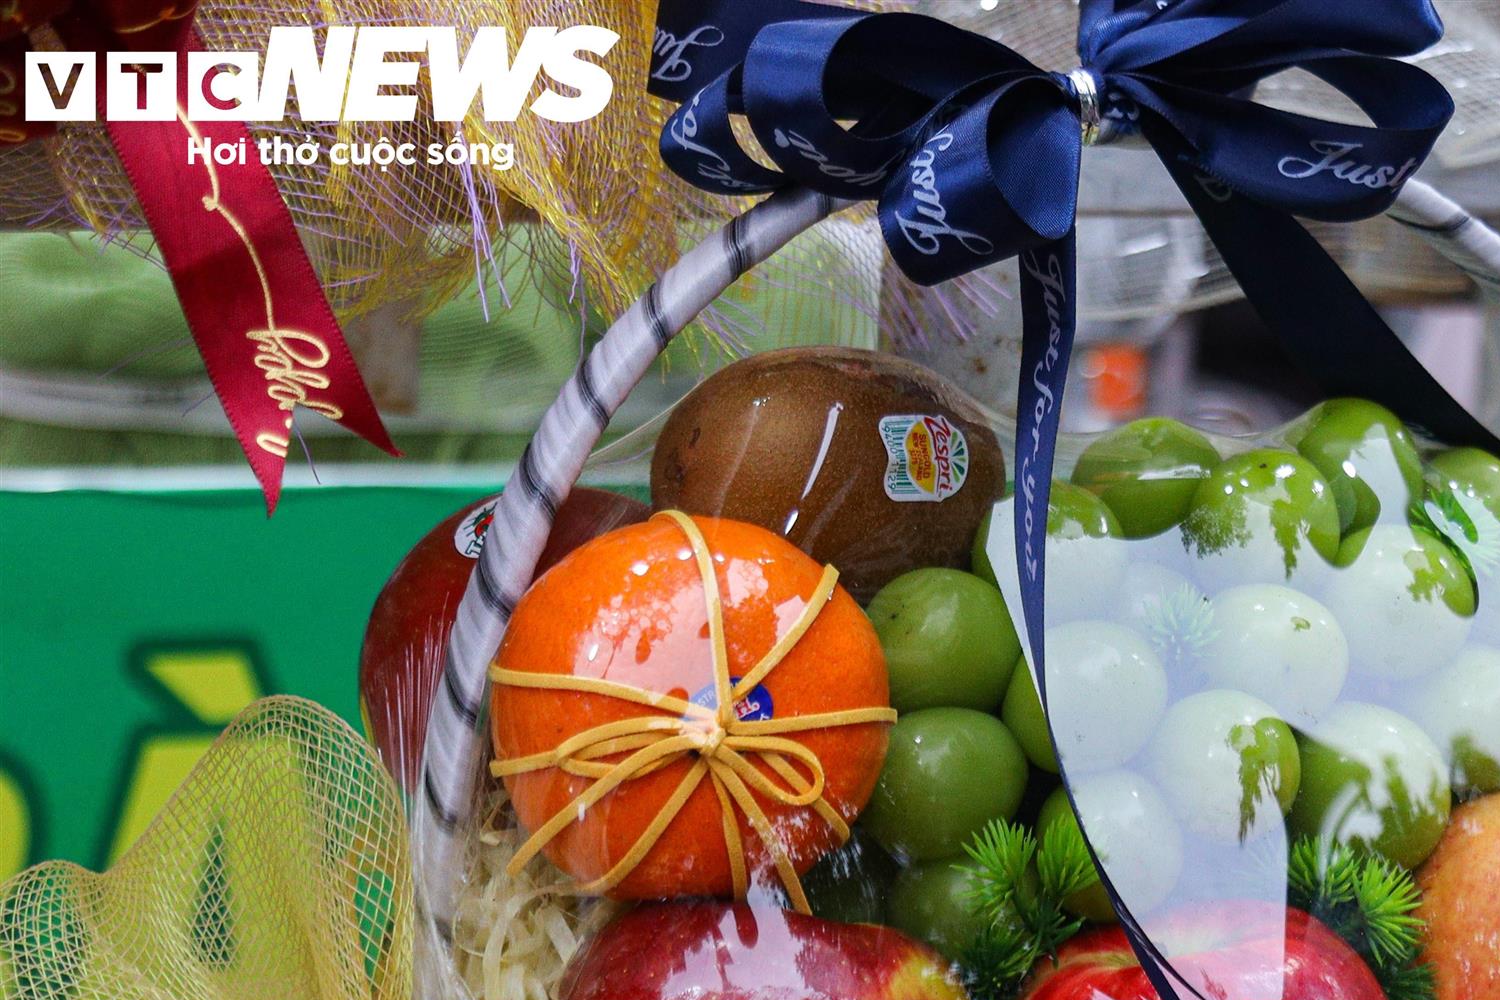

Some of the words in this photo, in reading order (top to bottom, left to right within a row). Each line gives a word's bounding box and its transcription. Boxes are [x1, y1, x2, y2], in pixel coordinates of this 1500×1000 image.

[895, 149, 994, 255] Just
[923, 416, 953, 492] Zespri
[1033, 359, 1054, 462] for
[1022, 457, 1037, 579] you
